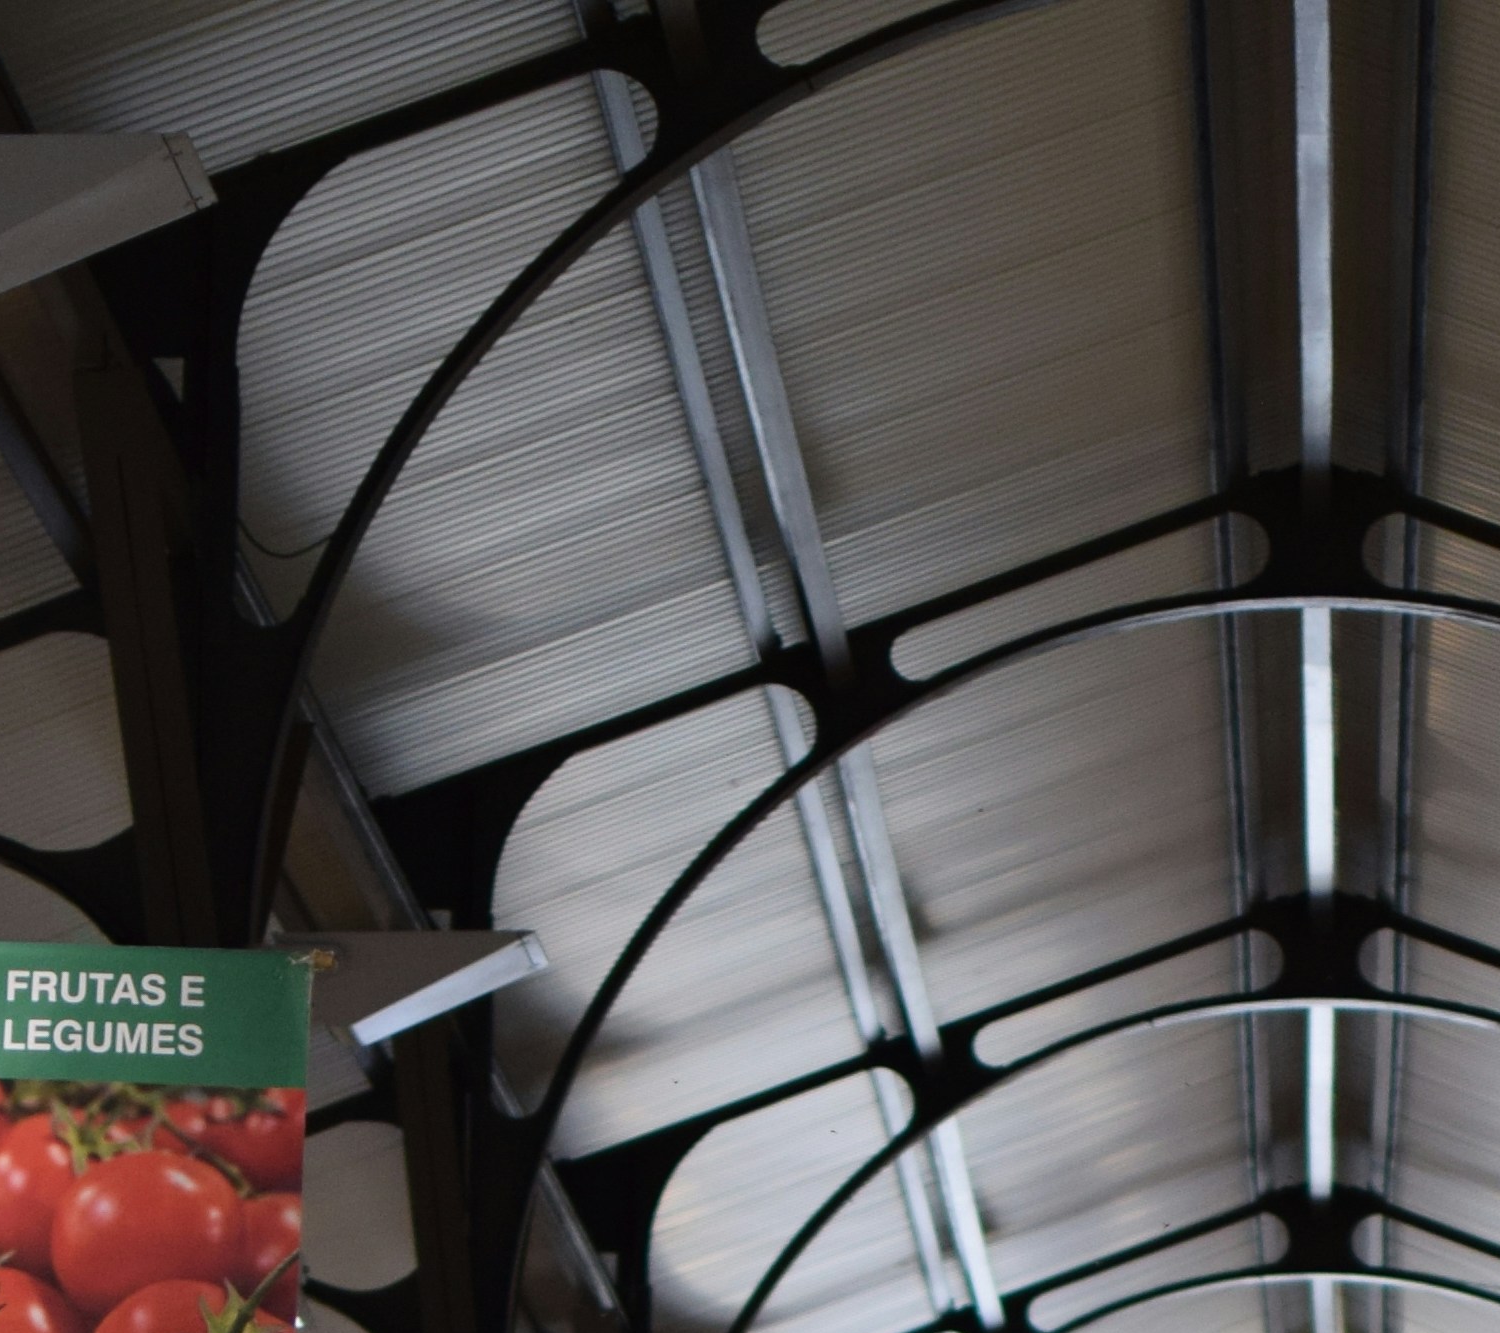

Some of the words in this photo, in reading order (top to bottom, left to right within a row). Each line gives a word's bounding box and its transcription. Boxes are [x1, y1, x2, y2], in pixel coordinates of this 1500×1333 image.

[6, 970, 167, 1006] FRUTAS
[180, 975, 205, 1007] E
[3, 1018, 204, 1056] LEGUMES
